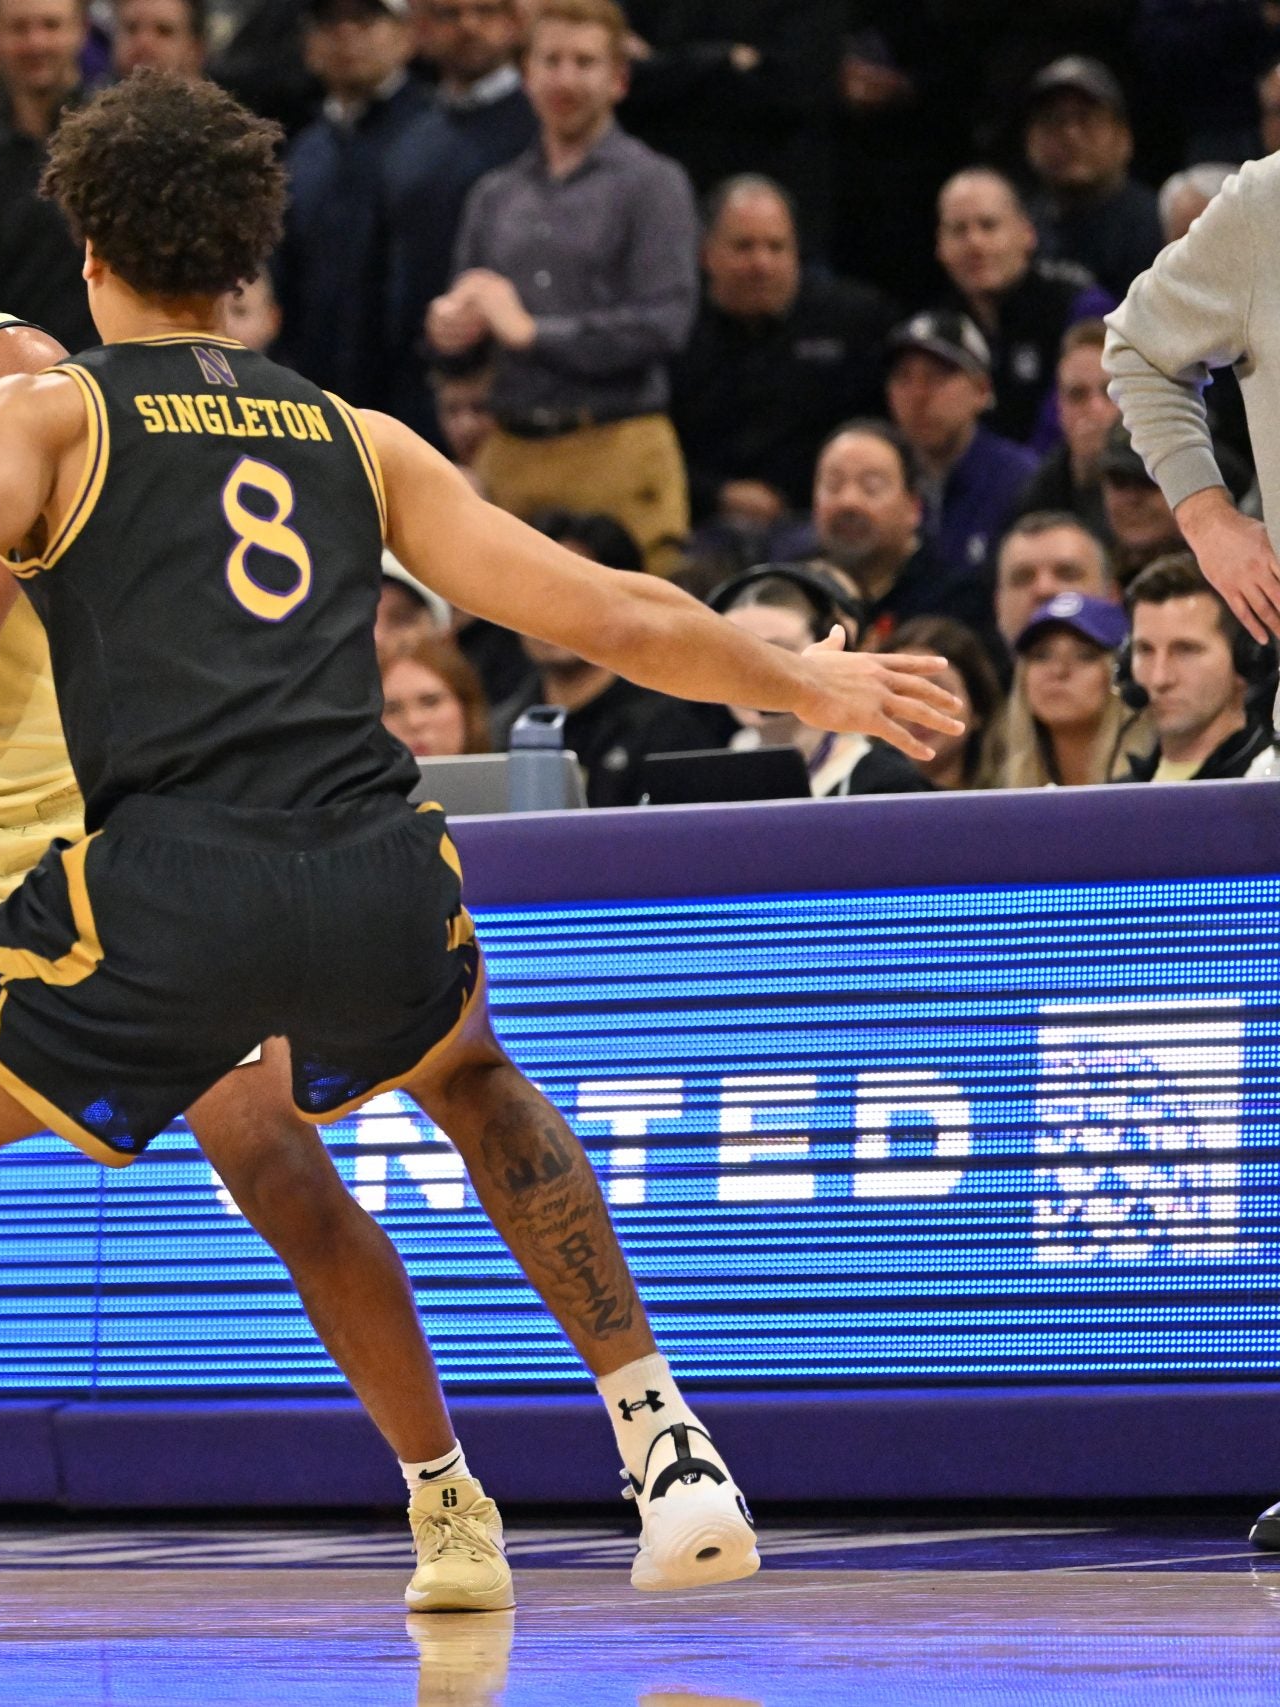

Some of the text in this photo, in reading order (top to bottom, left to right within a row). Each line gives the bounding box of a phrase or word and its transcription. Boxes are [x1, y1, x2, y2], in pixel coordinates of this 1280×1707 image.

[191, 346, 238, 388] N
[134, 394, 333, 442] SINGLETON
[222, 454, 313, 624] 8
[208, 1070, 971, 1214] NTED
